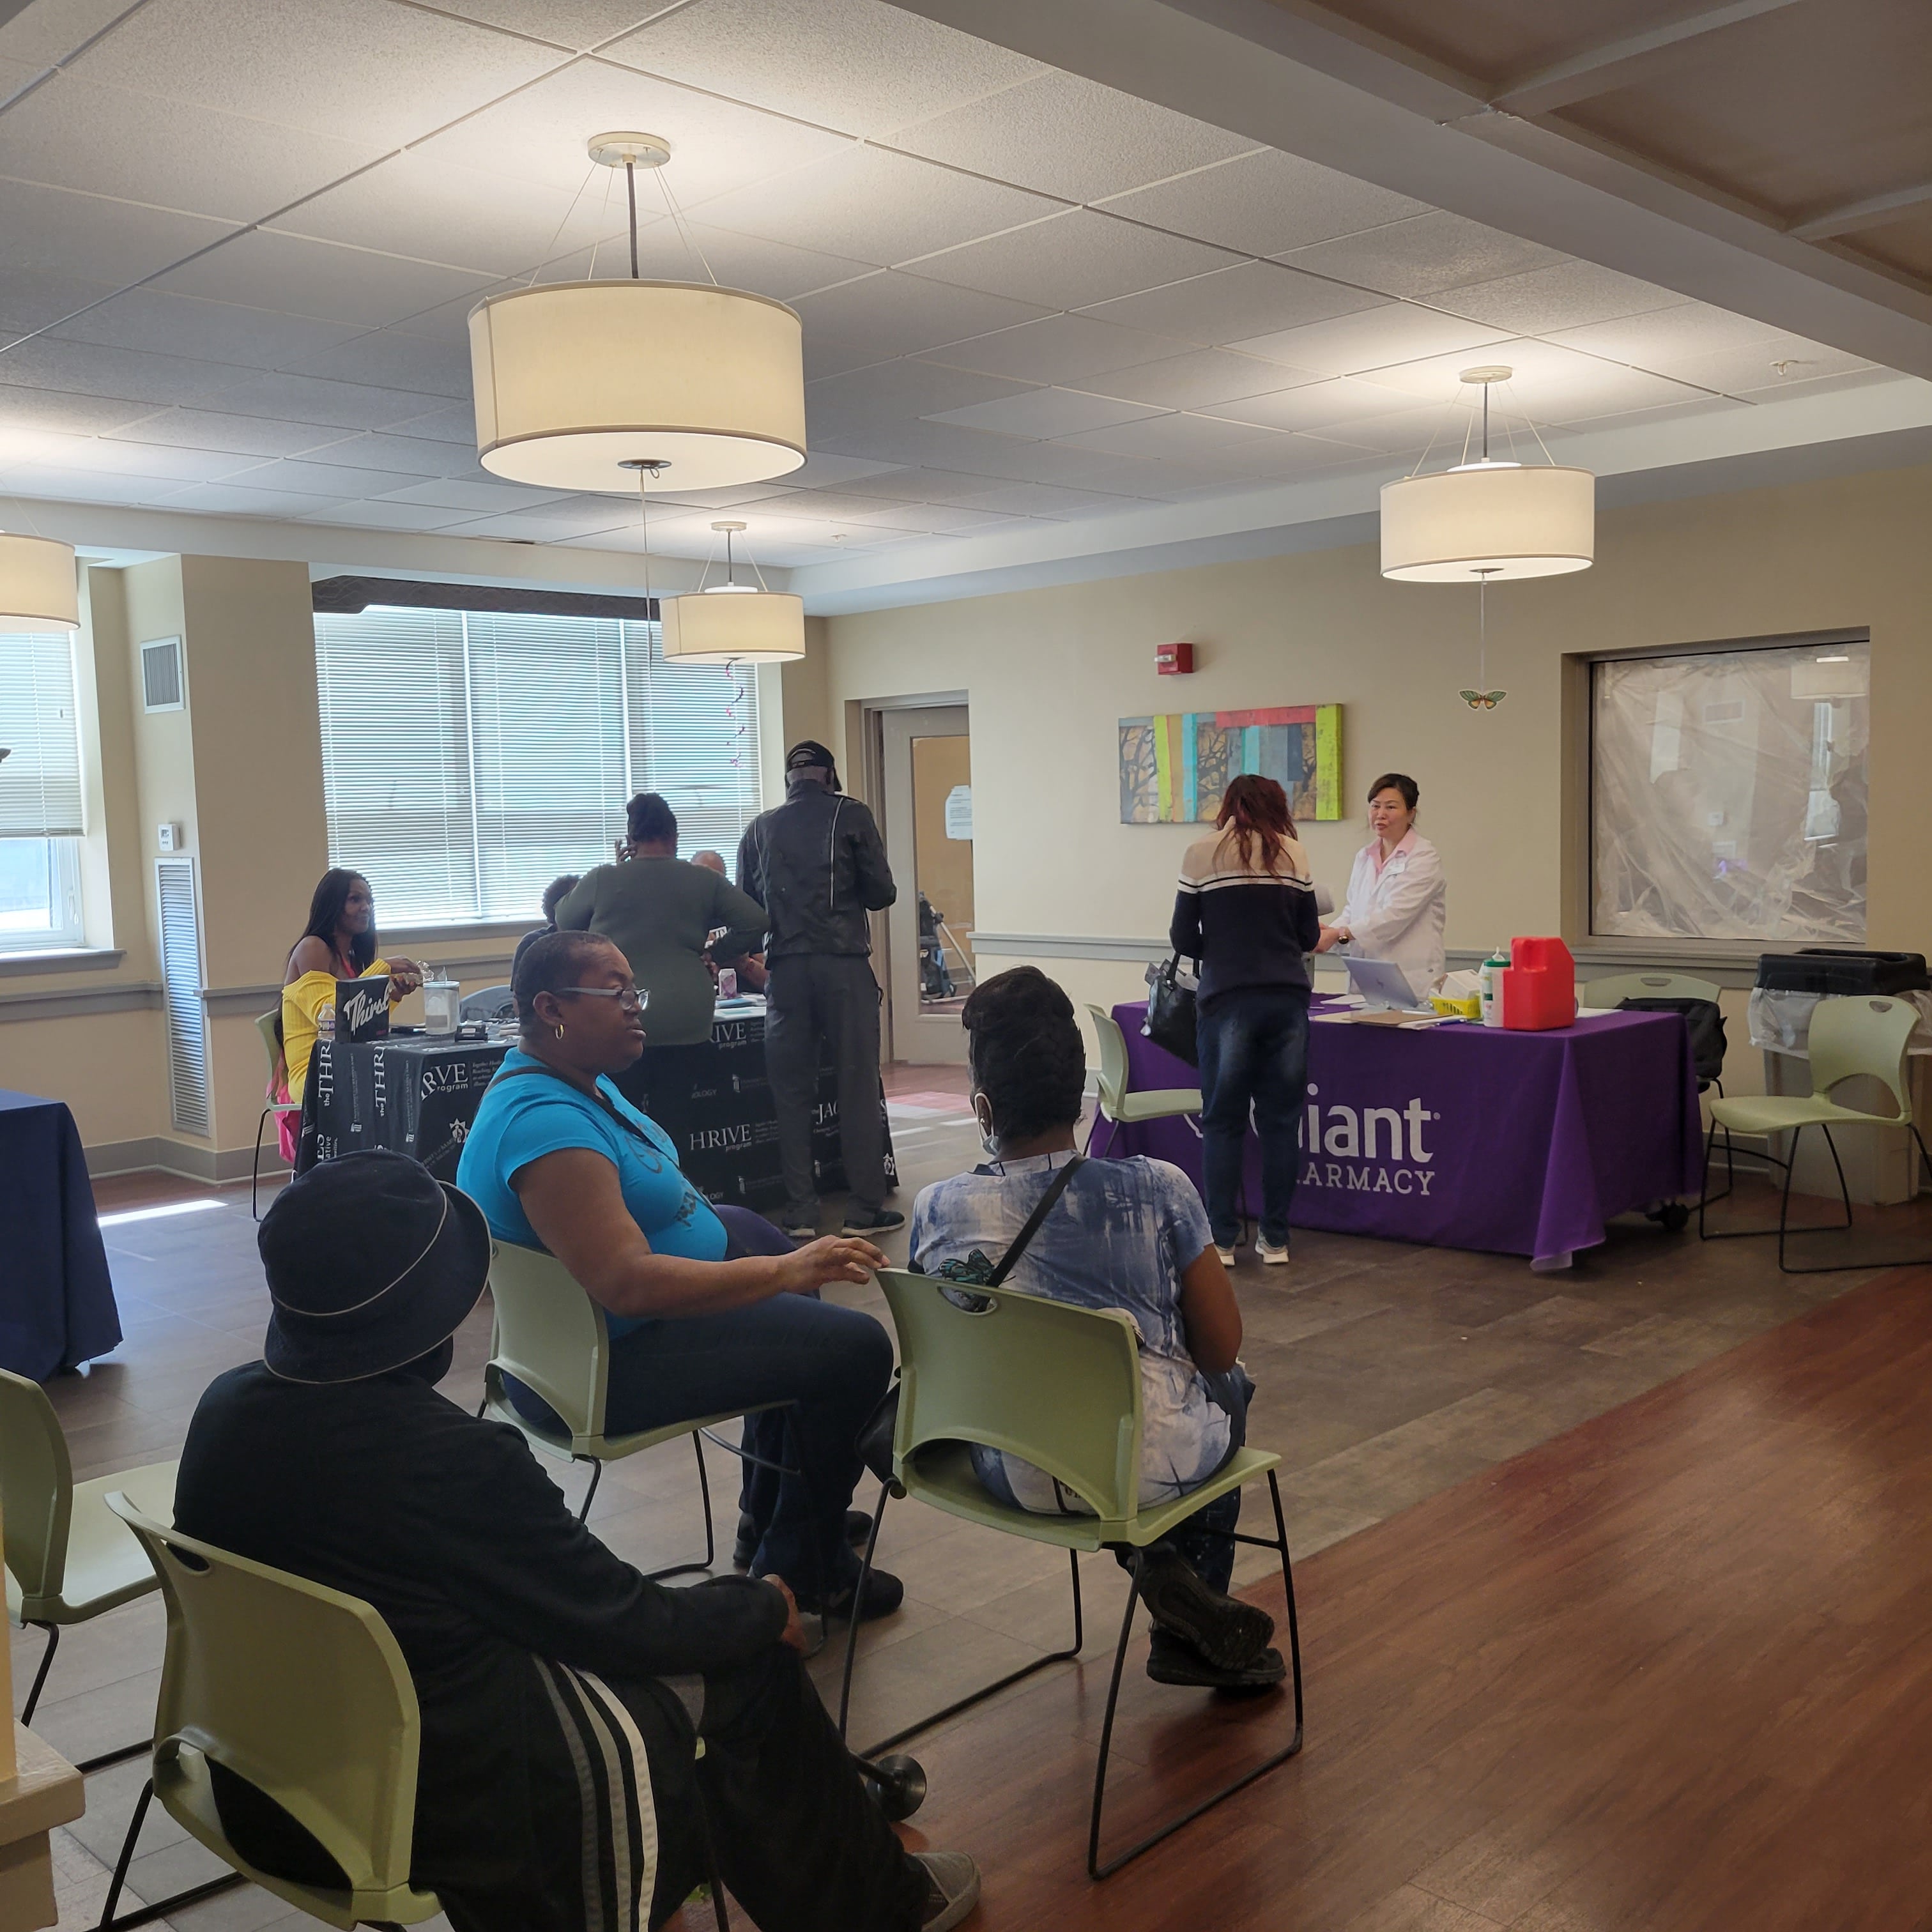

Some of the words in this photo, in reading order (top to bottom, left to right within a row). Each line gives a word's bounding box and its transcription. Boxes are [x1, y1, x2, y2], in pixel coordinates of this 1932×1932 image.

[709, 1022, 747, 1043] IVE
[437, 1083, 468, 1092] rogram
[1298, 1082, 1434, 1163] iant
[1296, 1162, 1436, 1196] ARMACY
